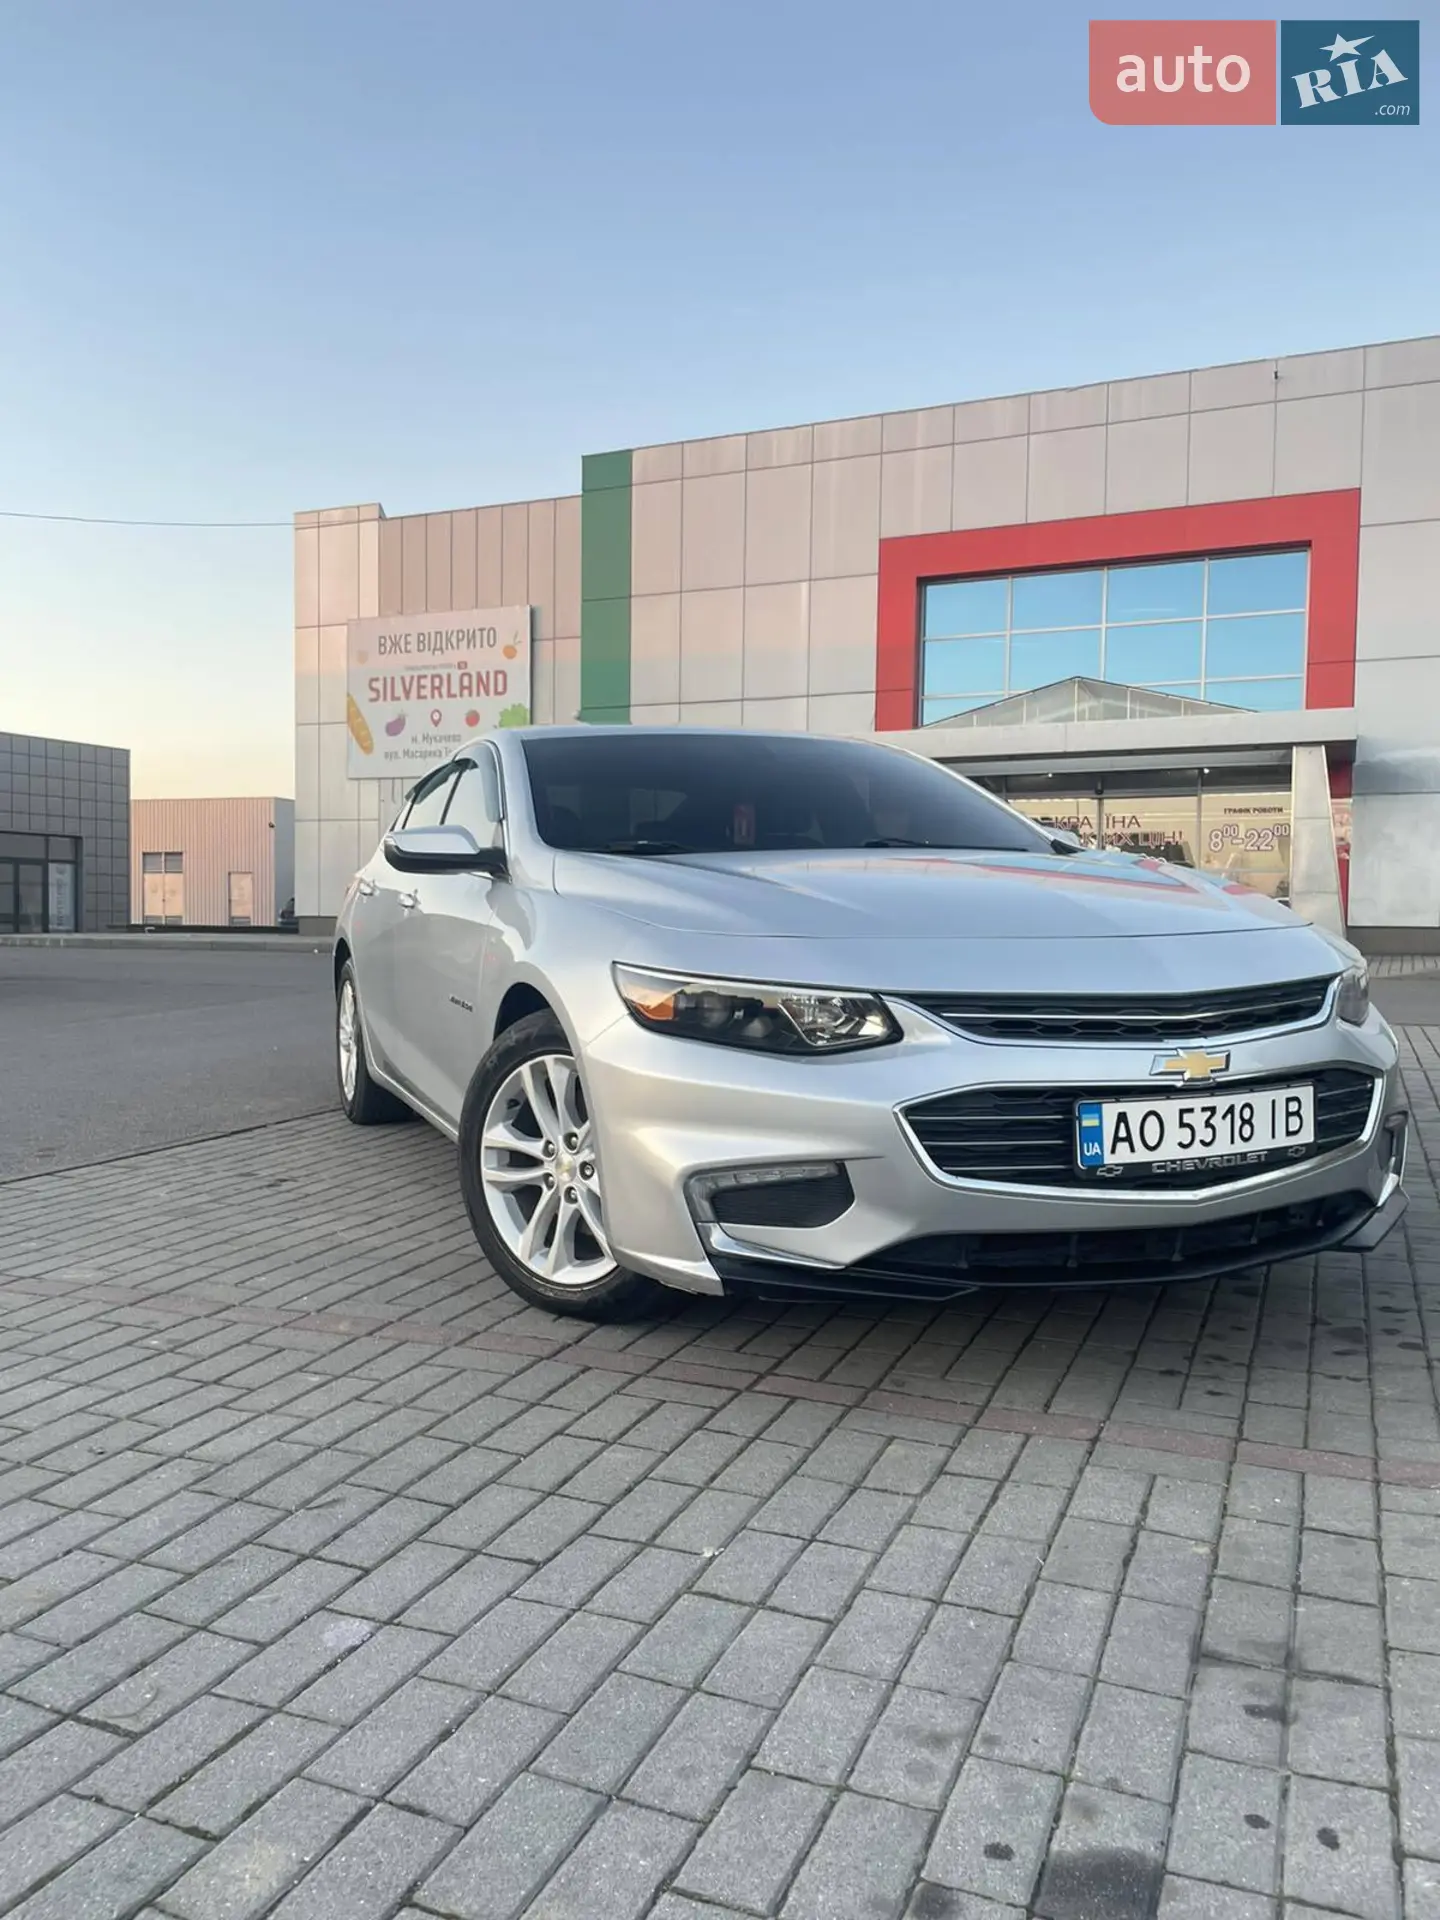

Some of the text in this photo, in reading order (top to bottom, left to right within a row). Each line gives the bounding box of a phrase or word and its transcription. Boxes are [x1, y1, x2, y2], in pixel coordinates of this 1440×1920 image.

[378, 627, 498, 656] ВЖЕ ВІДКРИТО
[368, 670, 508, 703] SILVERLAND
[1110, 1096, 1304, 1154] AO 5318 IB
[1084, 1142, 1101, 1156] UA
[1152, 1151, 1268, 1174] CHEVROLET
